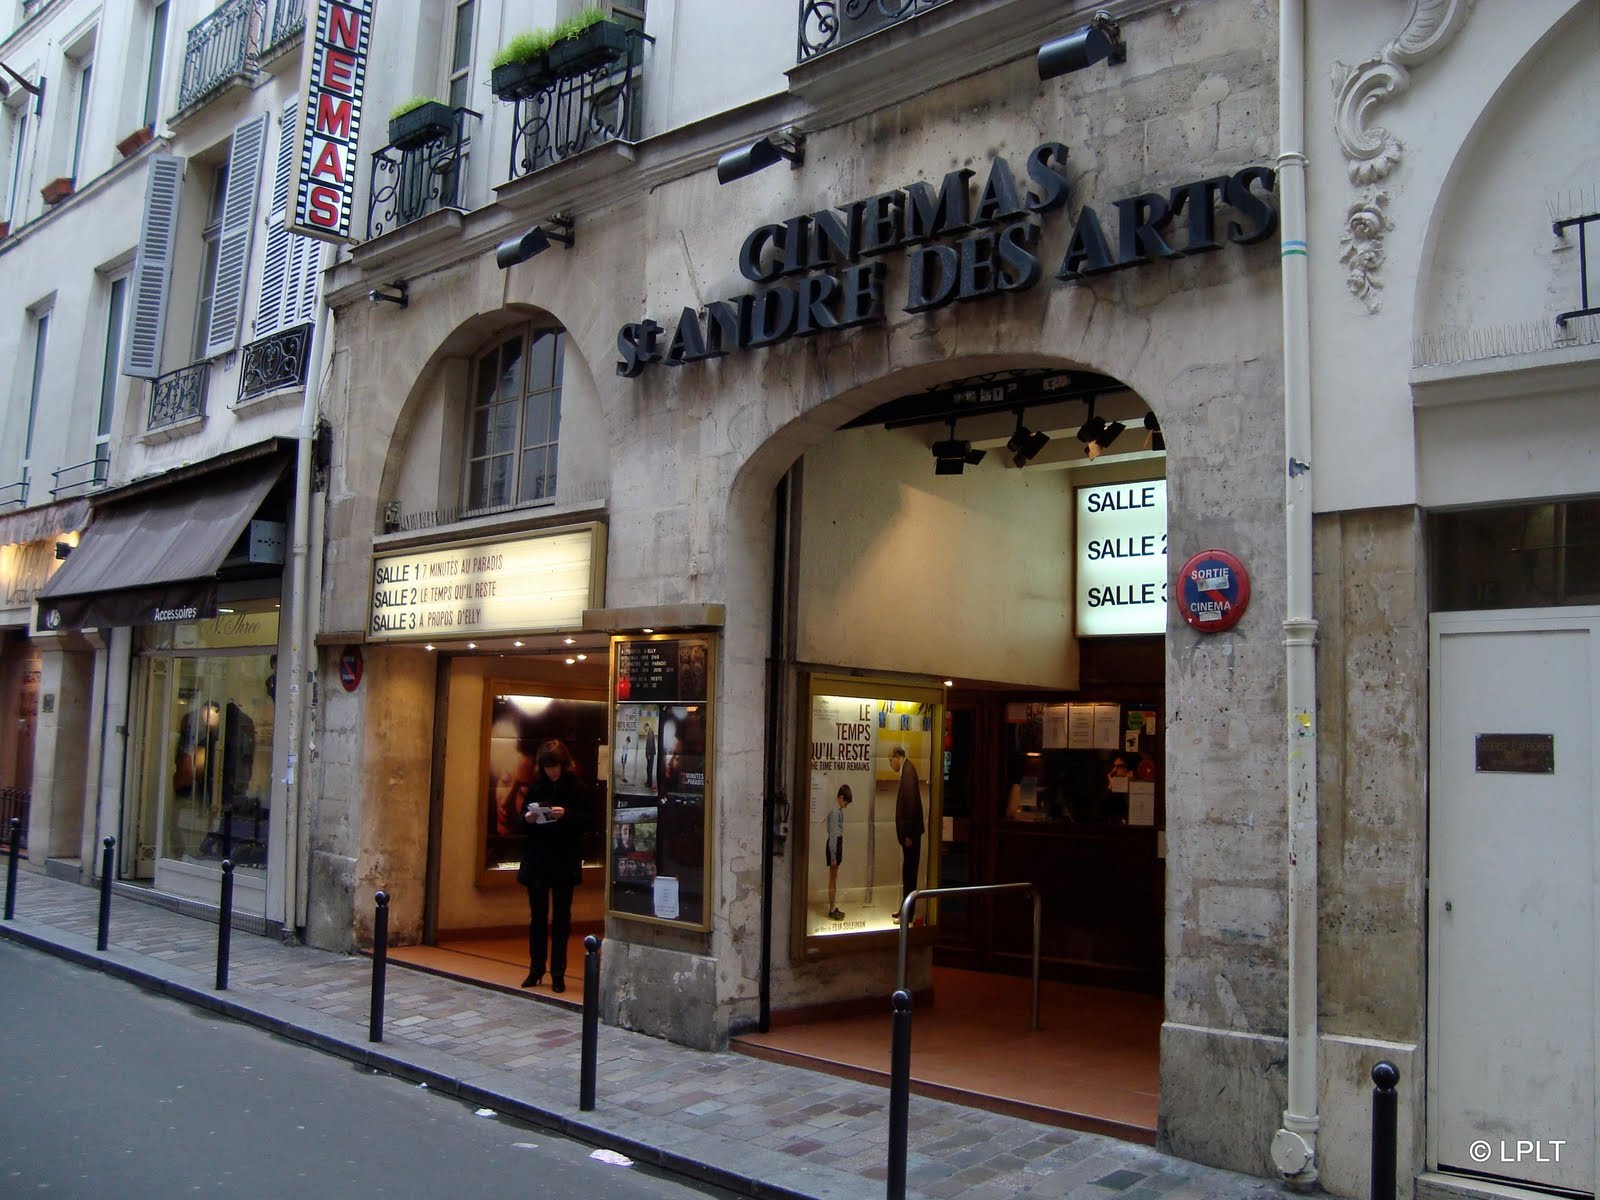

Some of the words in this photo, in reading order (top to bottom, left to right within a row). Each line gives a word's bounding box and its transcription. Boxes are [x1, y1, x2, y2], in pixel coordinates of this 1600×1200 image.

[308, 0, 359, 228] NEMAS
[740, 141, 1069, 284] CINEMAS
[616, 318, 664, 378] St
[663, 261, 887, 367] ANDRE
[904, 222, 1043, 314] DES
[1056, 166, 1278, 281] ARTS
[1087, 487, 1155, 513] SALLE
[1087, 535, 1155, 560] SALLE
[376, 564, 410, 585] SALLE
[415, 563, 419, 580] 1
[423, 564, 427, 579] 7
[429, 559, 459, 577] MINUTES
[461, 558, 471, 574] AU
[473, 554, 503, 573] PARADIS
[1191, 567, 1230, 580] SORTIE
[374, 589, 408, 608] SALLE
[410, 587, 417, 605] 2
[420, 588, 428, 602] LE
[431, 585, 453, 601] TEMPS
[454, 583, 472, 600] QU'IL
[475, 581, 497, 598] RESTE
[1087, 583, 1155, 608] SALLE
[1190, 601, 1231, 612] CINEMA
[154, 605, 197, 621] Accessoires
[373, 613, 407, 632] SALLE
[409, 612, 416, 630] 3
[419, 612, 424, 627] A
[427, 610, 454, 626] PROPOS
[457, 608, 482, 625] D'ELLY
[860, 704, 871, 721] LE
[836, 723, 871, 741] TEMPS
[839, 743, 870, 761] RESTE
[819, 761, 832, 770] TIME
[833, 761, 846, 770] THAT
[847, 762, 870, 771] REMAINS
